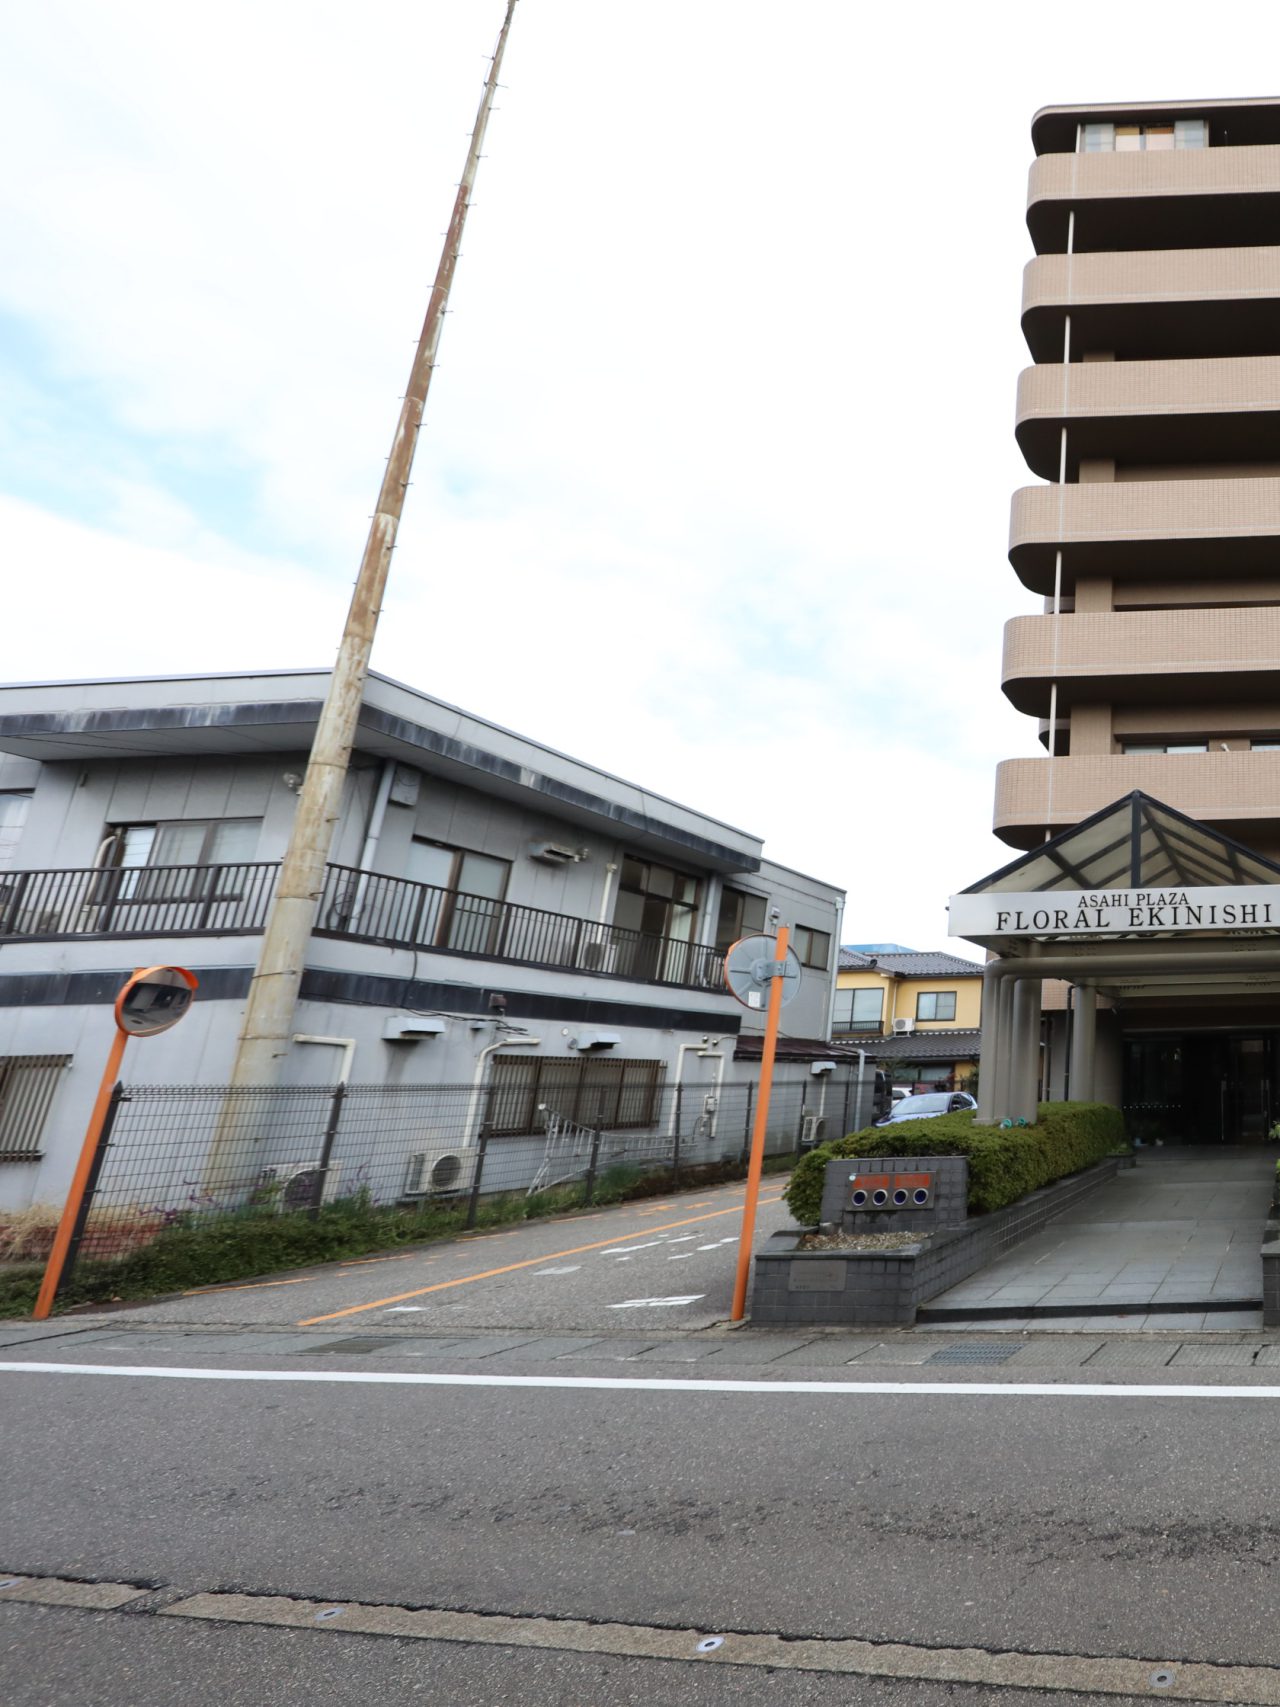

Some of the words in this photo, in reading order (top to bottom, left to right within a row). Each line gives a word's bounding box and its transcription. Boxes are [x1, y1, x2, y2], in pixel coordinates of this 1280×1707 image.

[1078, 893, 1129, 908] ASAHI
[1136, 892, 1190, 906] PLAZA
[996, 908, 1110, 931] FLORAL
[1128, 903, 1272, 927] EKINISHI
